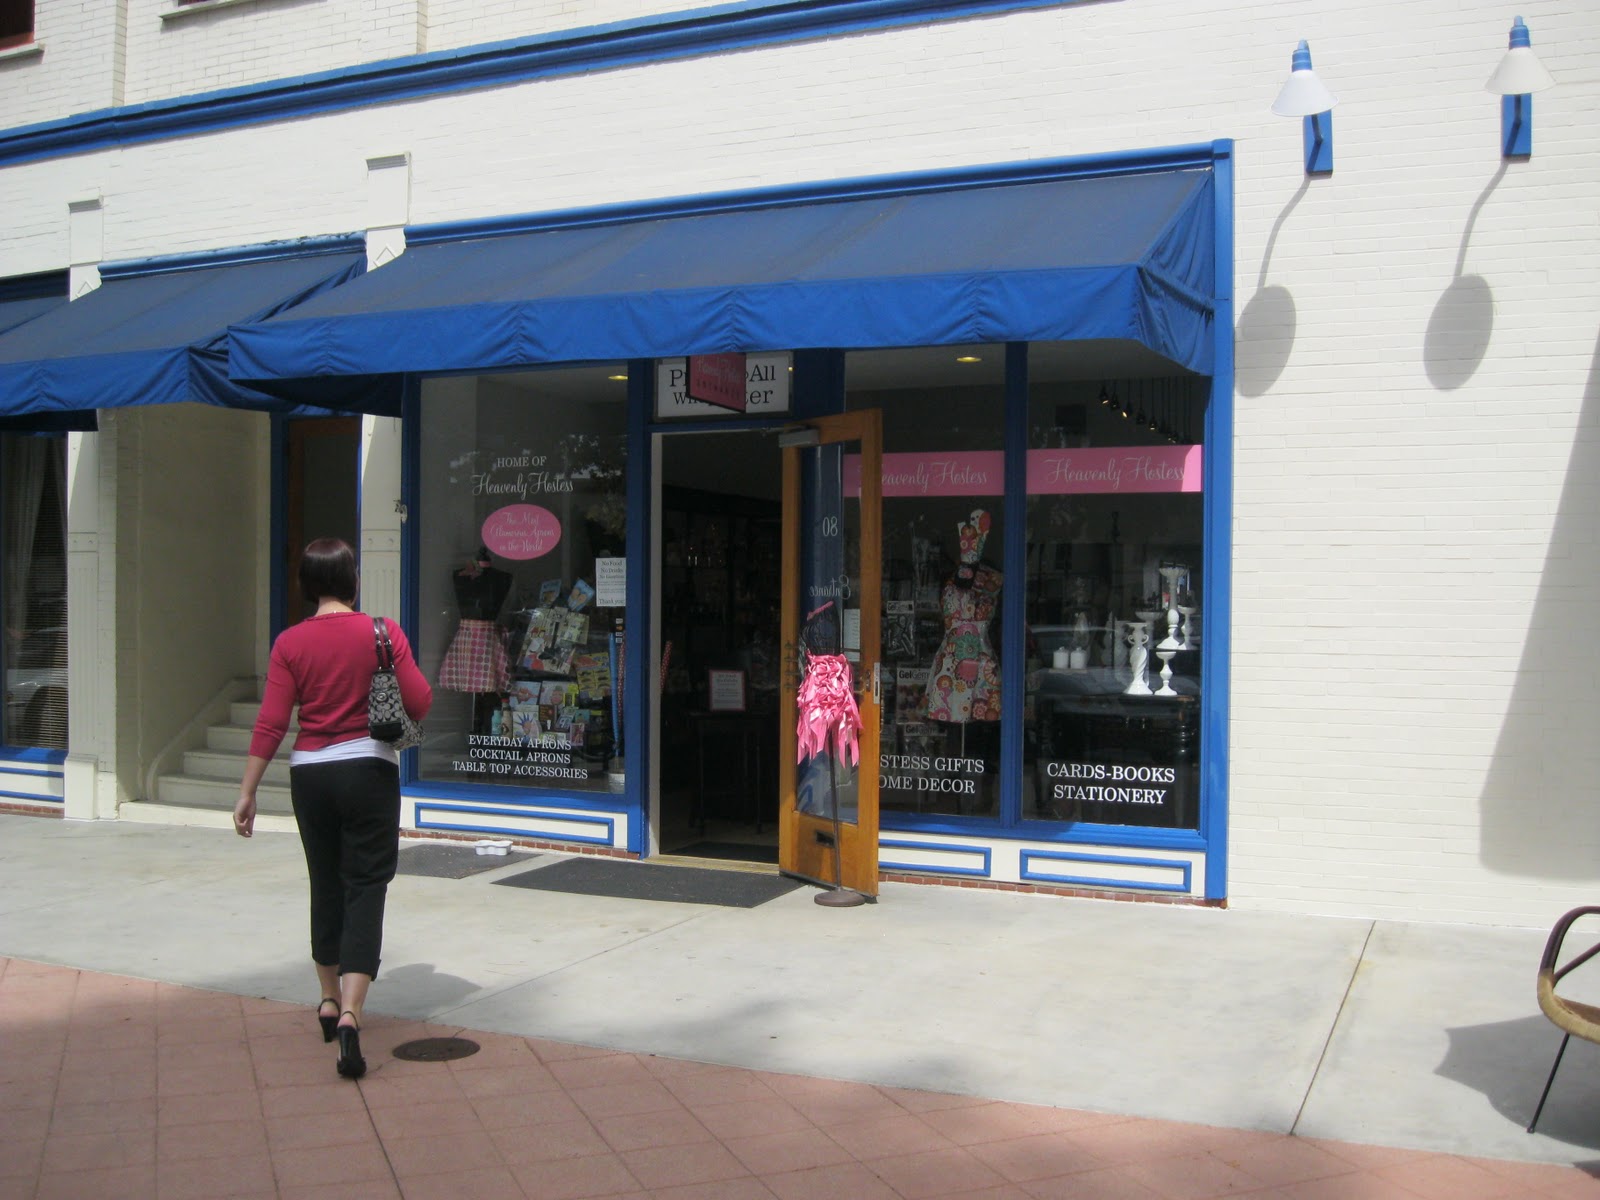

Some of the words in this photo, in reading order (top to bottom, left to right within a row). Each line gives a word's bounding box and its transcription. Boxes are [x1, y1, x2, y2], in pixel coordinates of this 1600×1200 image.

[497, 456, 529, 468] HOME
[532, 455, 547, 466] OF
[881, 462, 929, 493] eavenly
[931, 460, 987, 487] Hostess
[1043, 457, 1121, 489] Heavenly
[1124, 456, 1185, 481] Hostess
[472, 472, 528, 500] Heavenly
[528, 471, 574, 494] Hostess
[502, 511, 519, 525] The
[899, 670, 930, 680] GelGem
[469, 734, 524, 747] EVERYDAY
[527, 738, 572, 750] APRONS
[469, 748, 523, 761] COCKTAIL
[526, 751, 571, 764] APRONS
[880, 754, 930, 770] STESS
[935, 757, 985, 773] GIFTS
[453, 761, 486, 772] TABLE
[489, 763, 511, 774] TOP
[514, 765, 588, 779] ACCESSORIES
[1047, 762, 1176, 783] CARDS-BOOKS
[879, 775, 912, 790] OME
[917, 778, 976, 794] DECOR
[1053, 784, 1167, 804] STATIONERY
